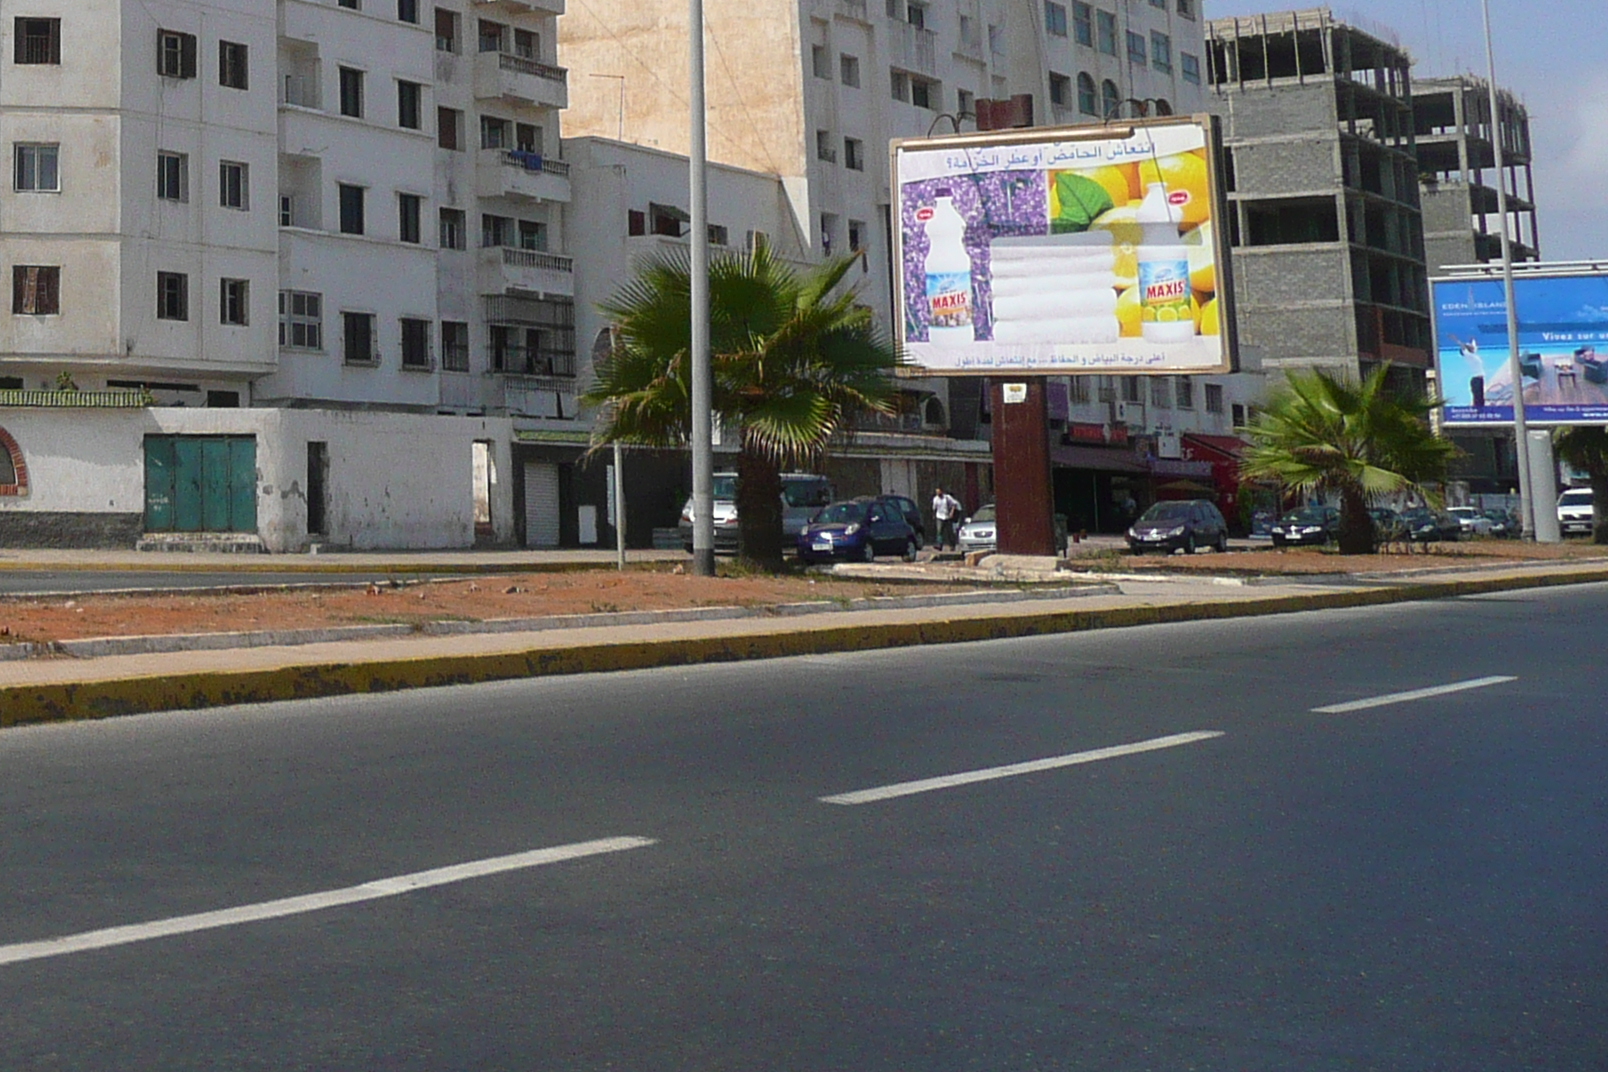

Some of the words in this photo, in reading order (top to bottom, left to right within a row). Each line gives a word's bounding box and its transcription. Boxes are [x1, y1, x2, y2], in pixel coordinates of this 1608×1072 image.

[1004, 153, 1029, 170] عطر
[1047, 146, 1102, 165] الحامض
[1147, 279, 1185, 299] MAXIS
[932, 291, 967, 309] MAXIS
[1441, 301, 1468, 310] EDEN
[1120, 352, 1144, 365] درجة
